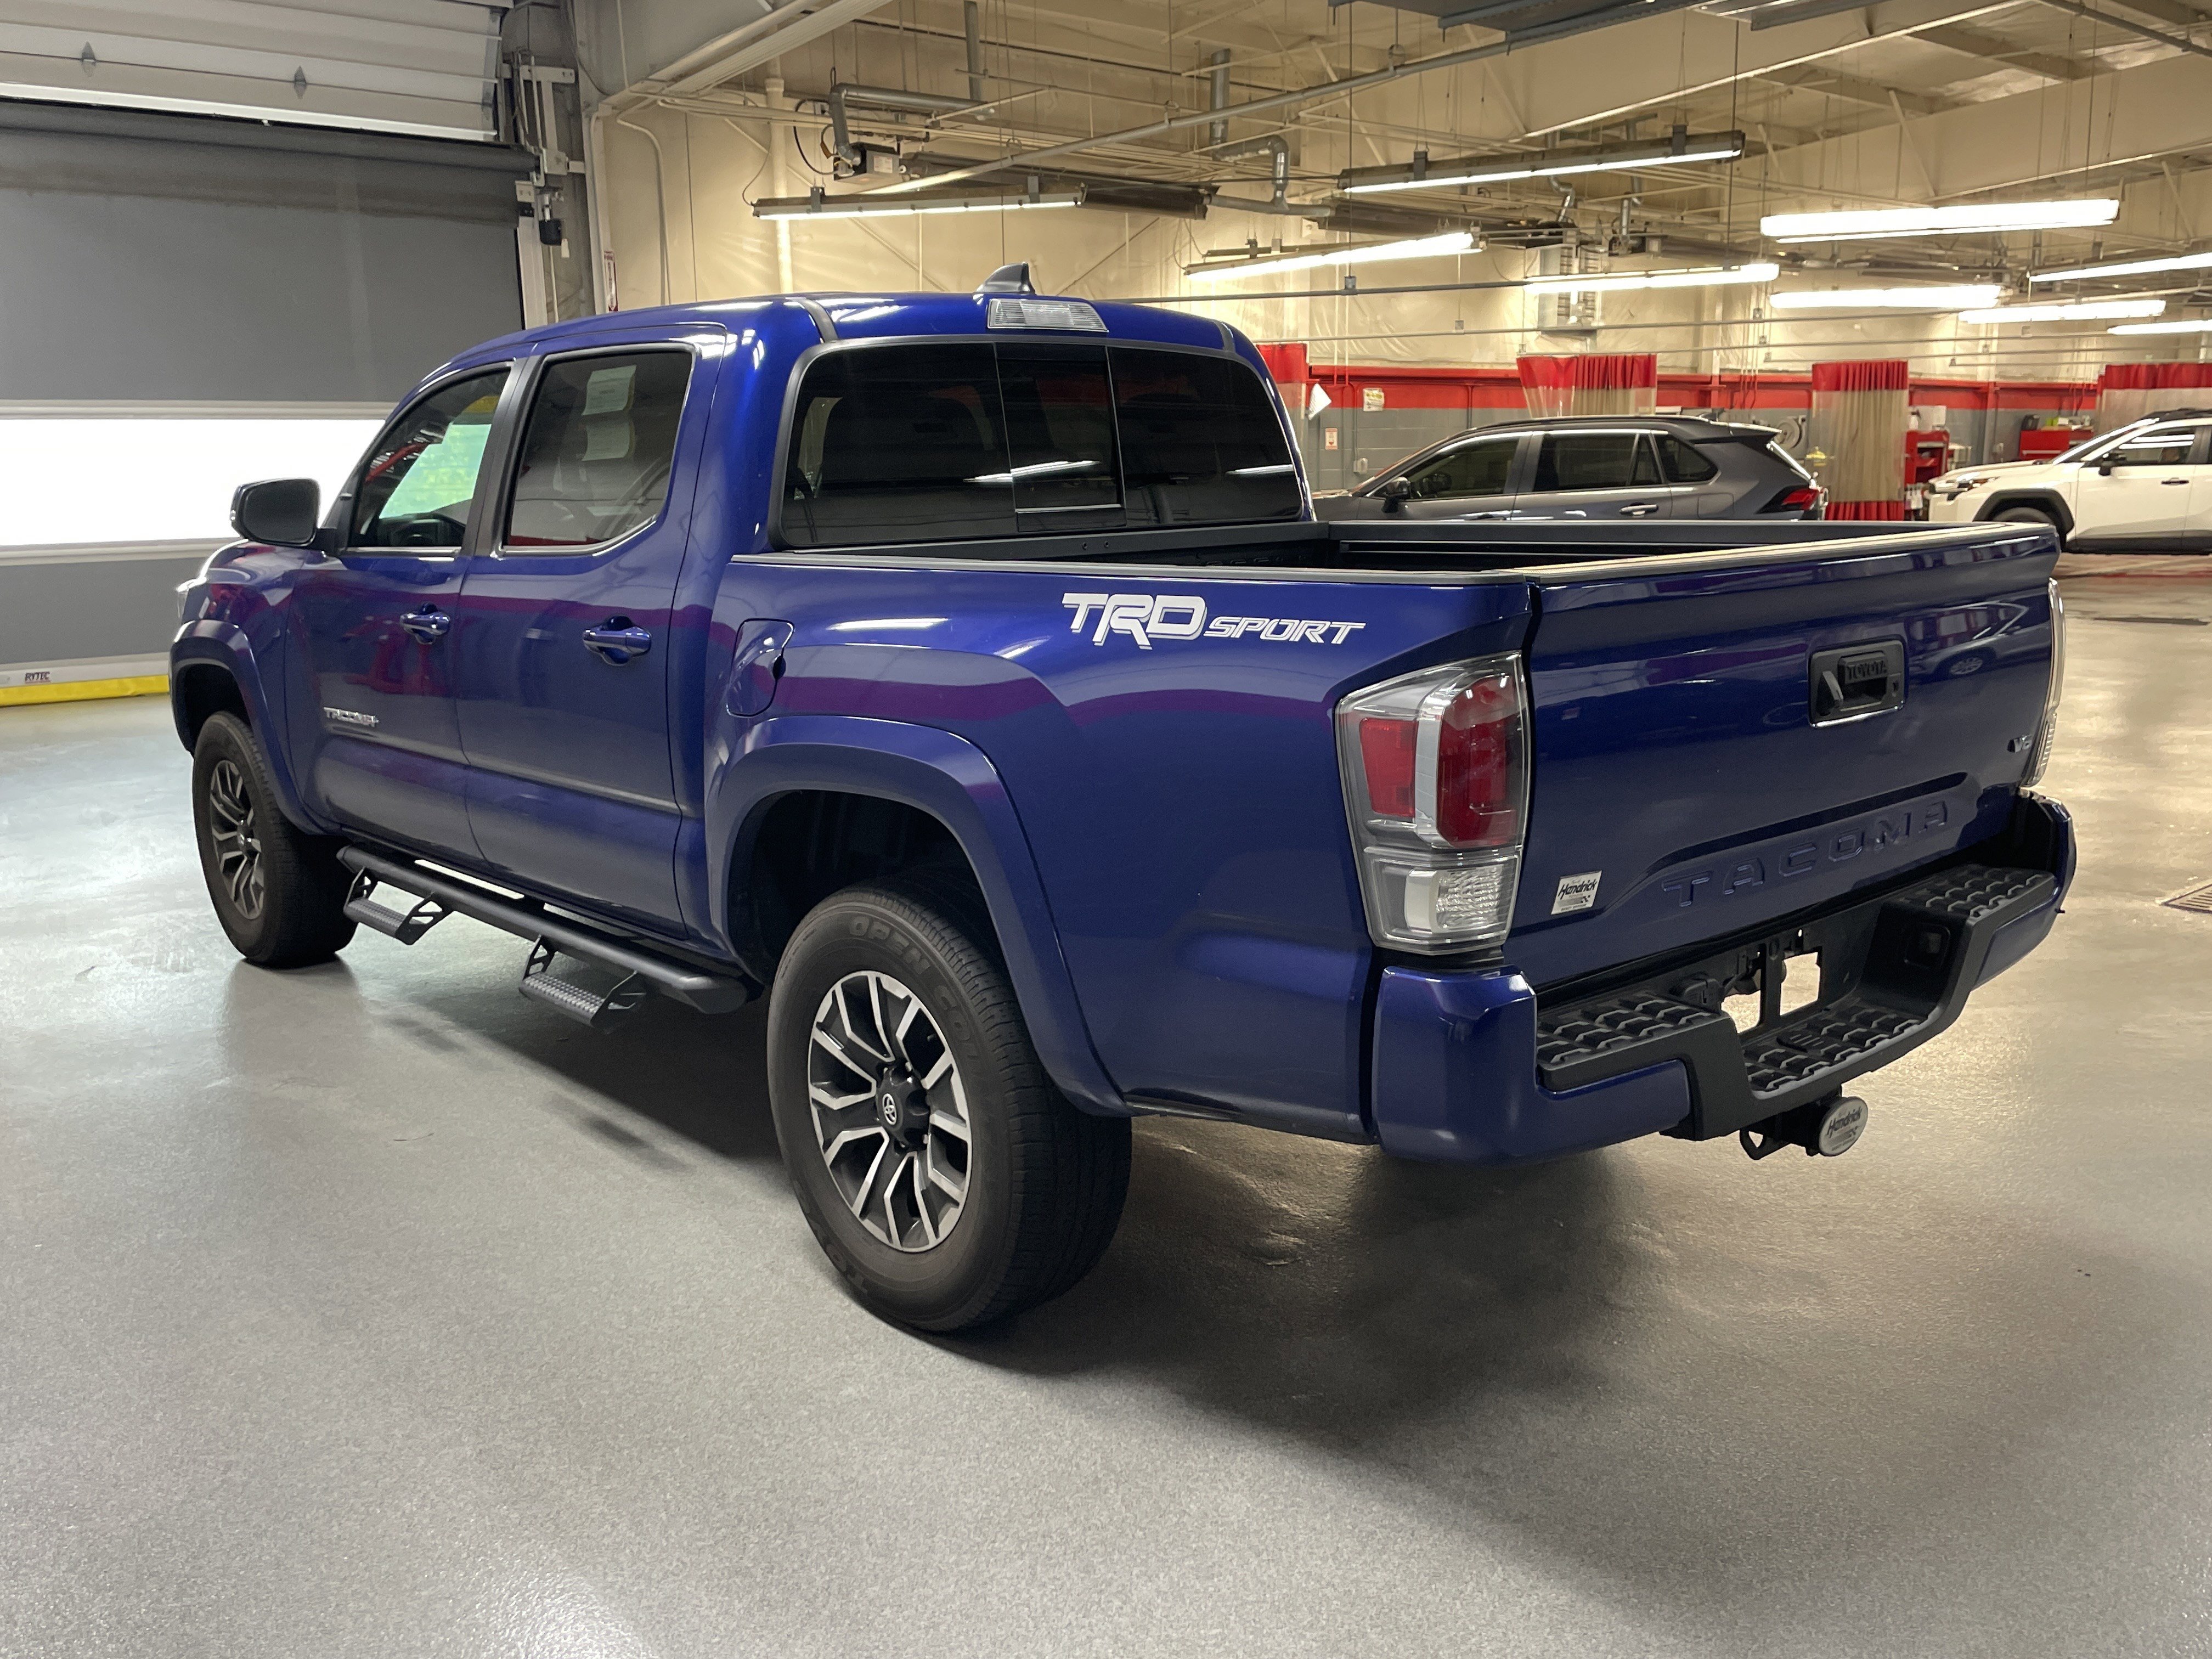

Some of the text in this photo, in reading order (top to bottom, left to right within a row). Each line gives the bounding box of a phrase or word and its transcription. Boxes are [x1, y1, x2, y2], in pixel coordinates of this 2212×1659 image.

[1062, 592, 1367, 650] TRD SPORT
[1846, 660, 1888, 680] TOYOTA
[2007, 734, 2033, 753] V6
[1662, 800, 1948, 907] TACOMA
[1558, 879, 1598, 900] Hendrick
[851, 916, 931, 974] OPEN
